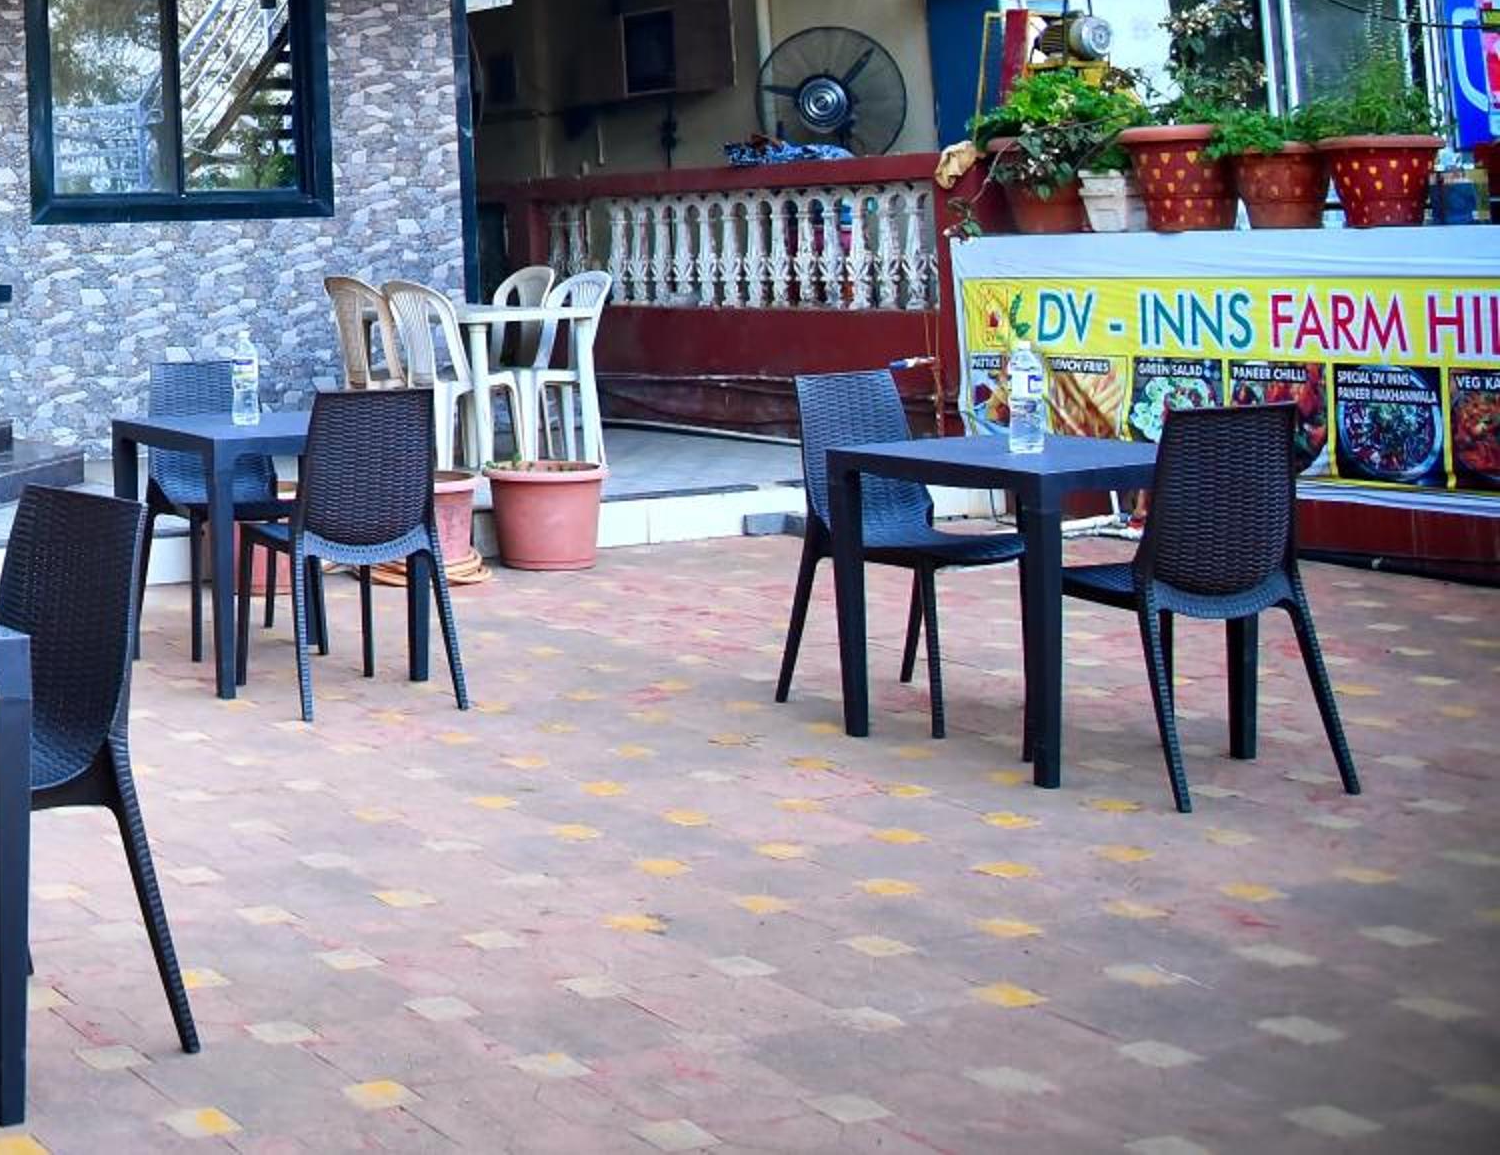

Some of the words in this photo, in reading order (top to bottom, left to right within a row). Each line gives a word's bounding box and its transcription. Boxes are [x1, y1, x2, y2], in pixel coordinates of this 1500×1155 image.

[1037, 292, 1093, 343] DV
[1140, 292, 1253, 348] INNS
[1271, 293, 1408, 353] FARM
[1139, 362, 1169, 375] GREEN
[1172, 364, 1203, 377] SALAD
[1233, 366, 1270, 379] PANEER
[1273, 367, 1306, 381] CHILLI
[1337, 370, 1370, 384] SPECIAL
[1456, 375, 1481, 389] VEG
[1337, 387, 1370, 400] PANEER
